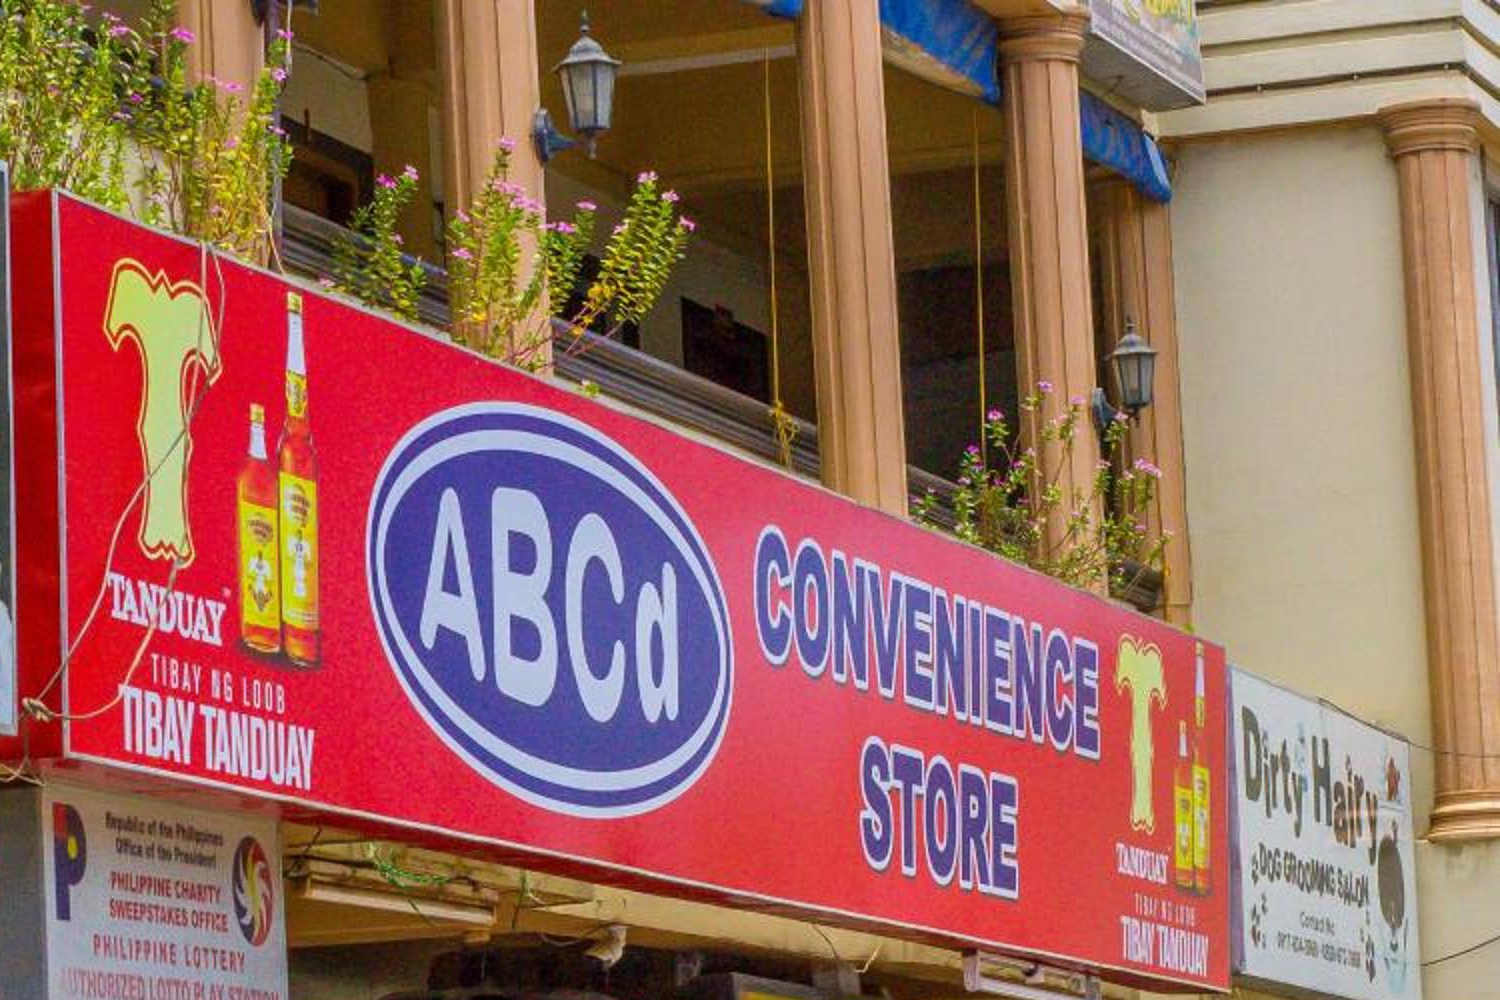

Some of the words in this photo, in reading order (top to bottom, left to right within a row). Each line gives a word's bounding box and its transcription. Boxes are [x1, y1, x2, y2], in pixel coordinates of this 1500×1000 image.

[107, 570, 227, 647] TANDUAY
[420, 486, 679, 724] ABCd
[753, 525, 1101, 761] CONVENIENCE
[152, 653, 201, 696] TIBAY
[211, 668, 234, 703] NG
[243, 677, 286, 715] LOOB
[118, 684, 196, 766] TIBAY
[199, 703, 315, 792] TANDUAY
[860, 735, 1020, 900] STORE
[1241, 704, 1303, 839] Dirty
[1311, 735, 1379, 867] Hairy
[105, 810, 145, 836] Republic
[148, 817, 157, 834] of
[115, 837, 144, 859] Office
[145, 841, 155, 859] of
[110, 870, 172, 897] PHILIPPINE
[174, 878, 222, 903] CHARITY
[1258, 841, 1282, 884] DOG
[1283, 848, 1337, 898] GROOMING
[1337, 870, 1370, 909] SALON
[109, 898, 189, 928] SWEEPSTAKES
[191, 907, 229, 933] OFFICE
[1121, 914, 1156, 966] TIBAY
[1156, 924, 1209, 977] TANDUAY
[92, 934, 178, 966] PHILIPPINE
[184, 944, 246, 974] LOTTERY
